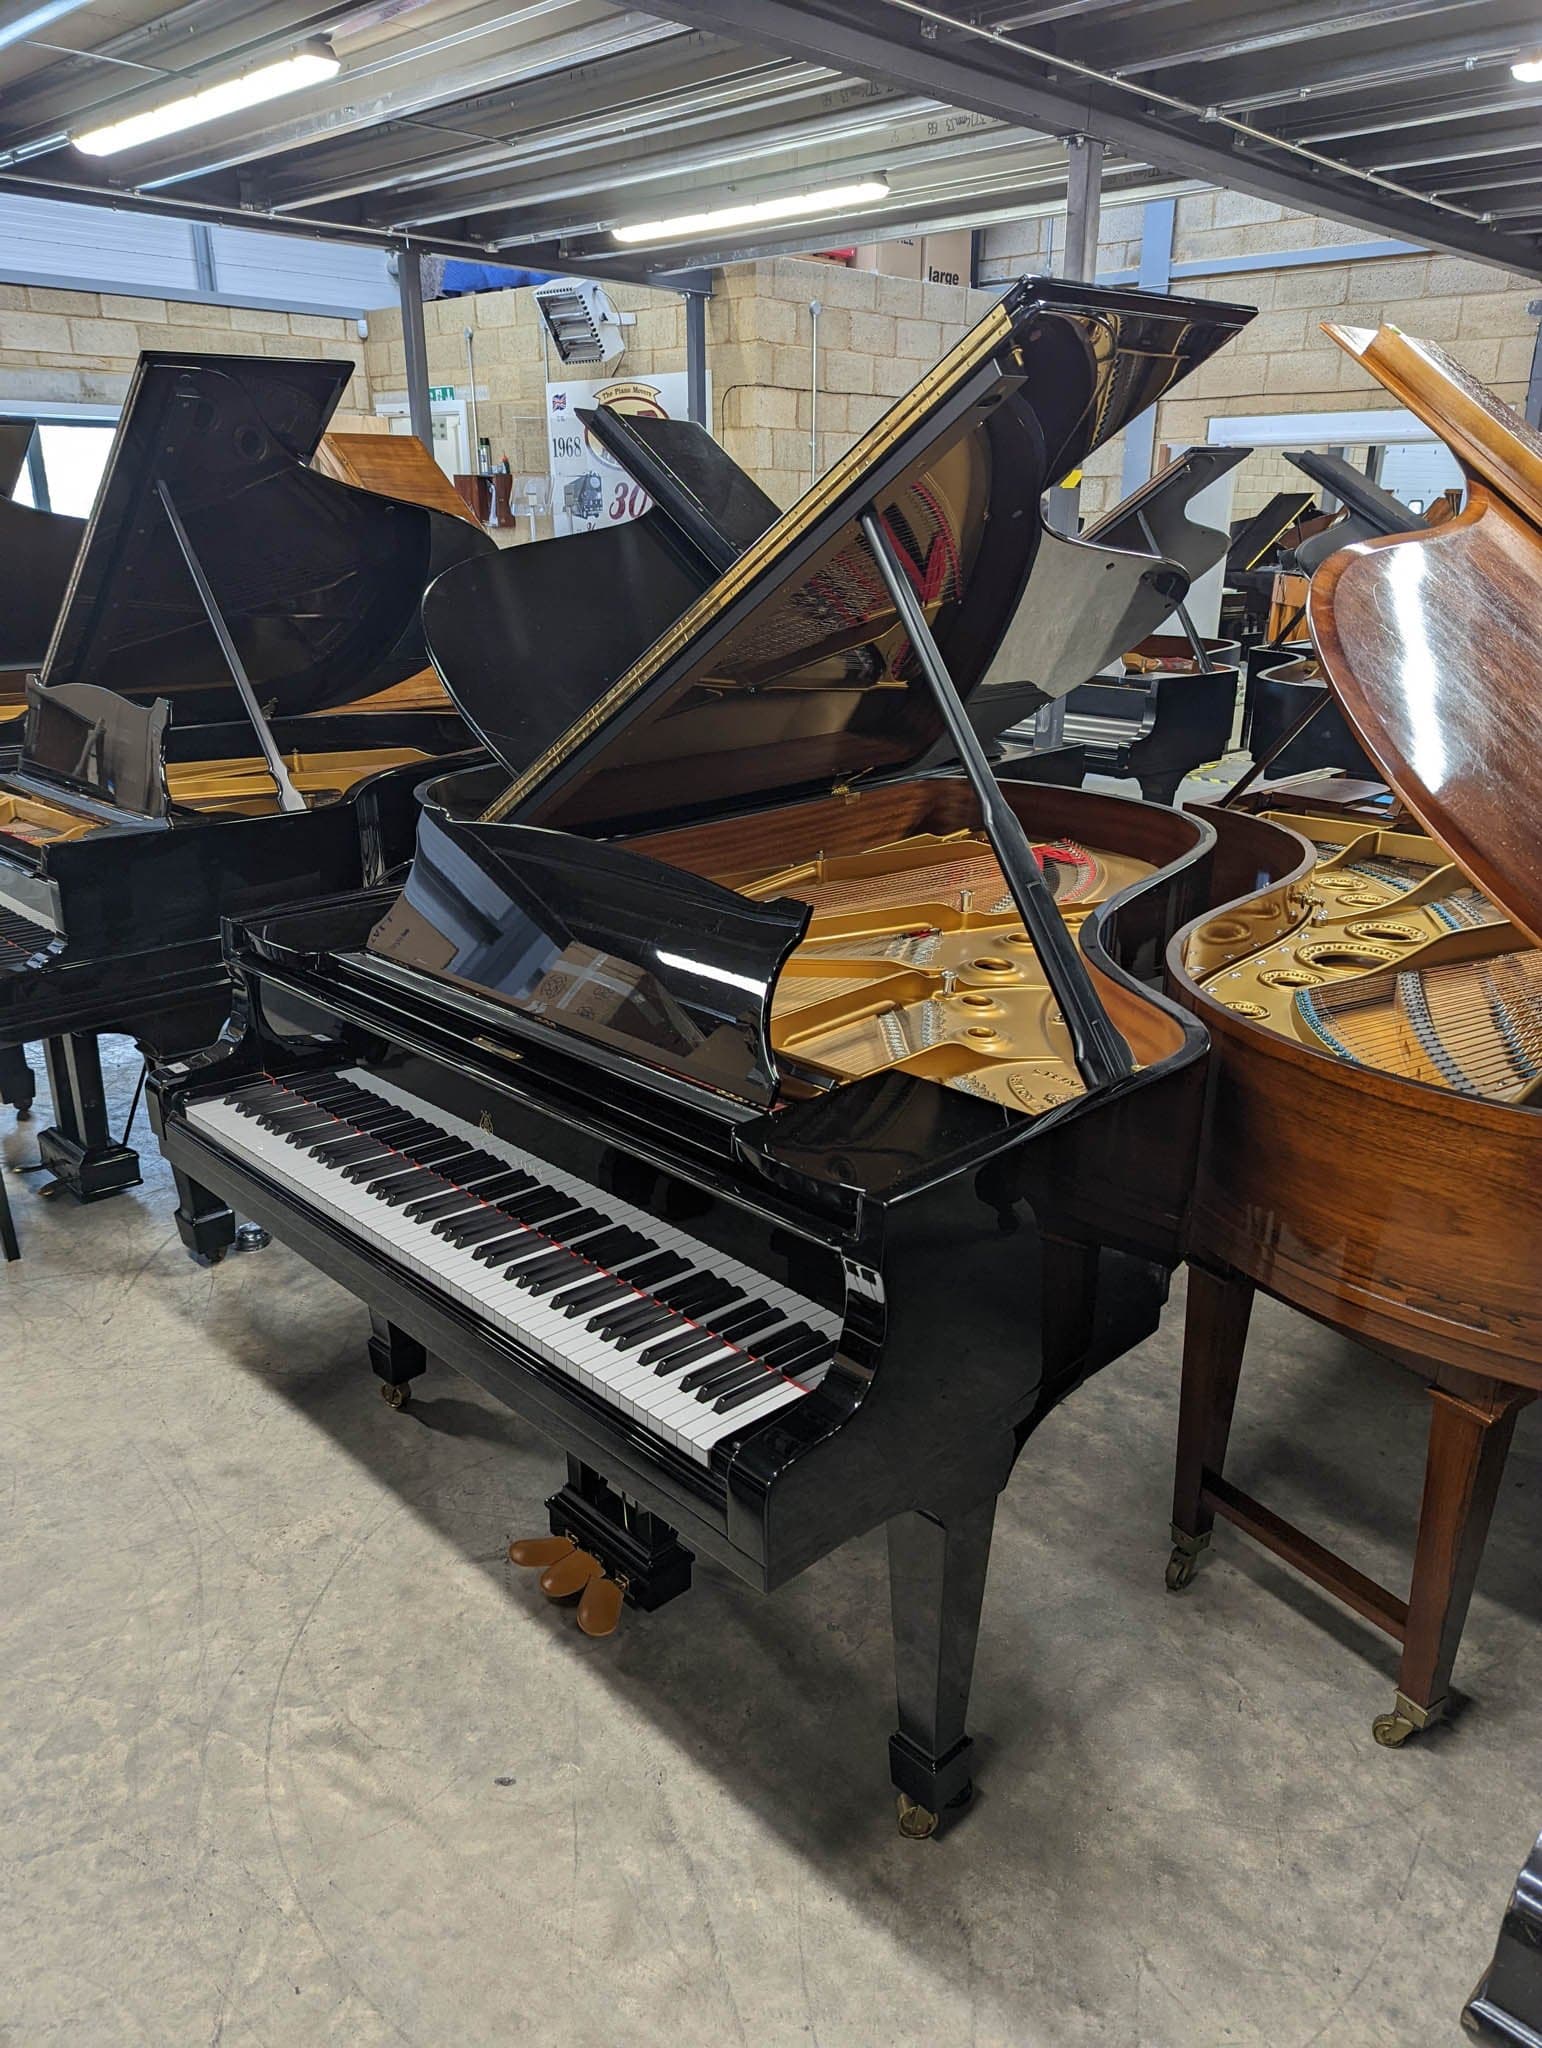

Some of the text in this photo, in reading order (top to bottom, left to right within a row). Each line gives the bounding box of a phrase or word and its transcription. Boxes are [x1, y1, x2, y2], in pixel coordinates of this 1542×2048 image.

[928, 265, 960, 286] large
[602, 386, 652, 399] The Piano Movers
[552, 436, 582, 458] 1968
[609, 482, 648, 520] 30
